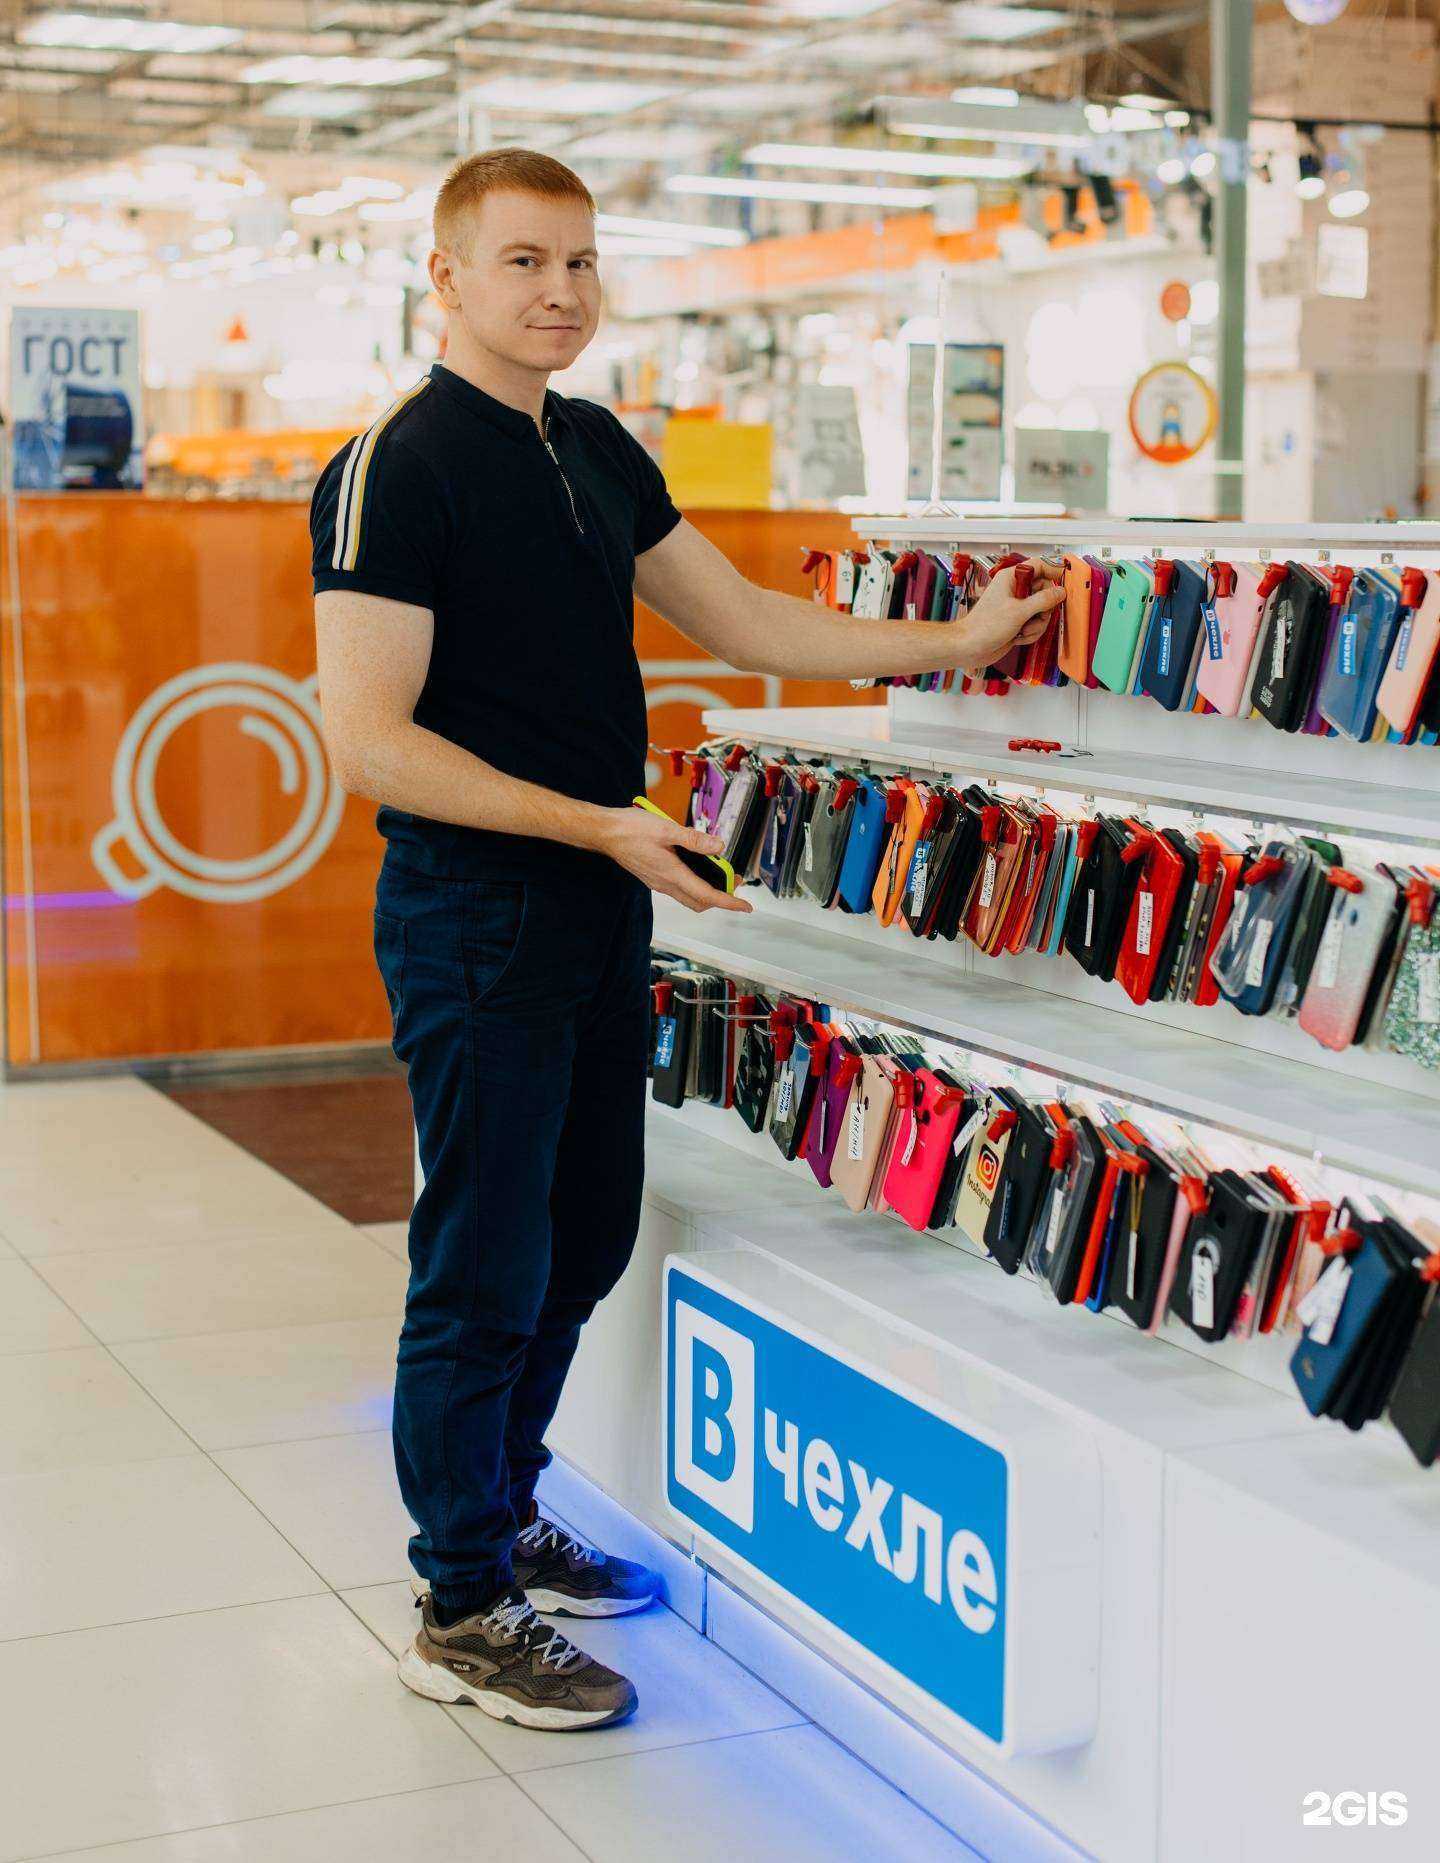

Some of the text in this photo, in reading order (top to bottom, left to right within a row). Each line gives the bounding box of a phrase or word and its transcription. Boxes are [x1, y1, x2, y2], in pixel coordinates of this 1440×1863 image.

[23, 336, 127, 376] ГОСТ
[967, 1174, 991, 1208] Instagra
[691, 1335, 998, 1635] В чехле
